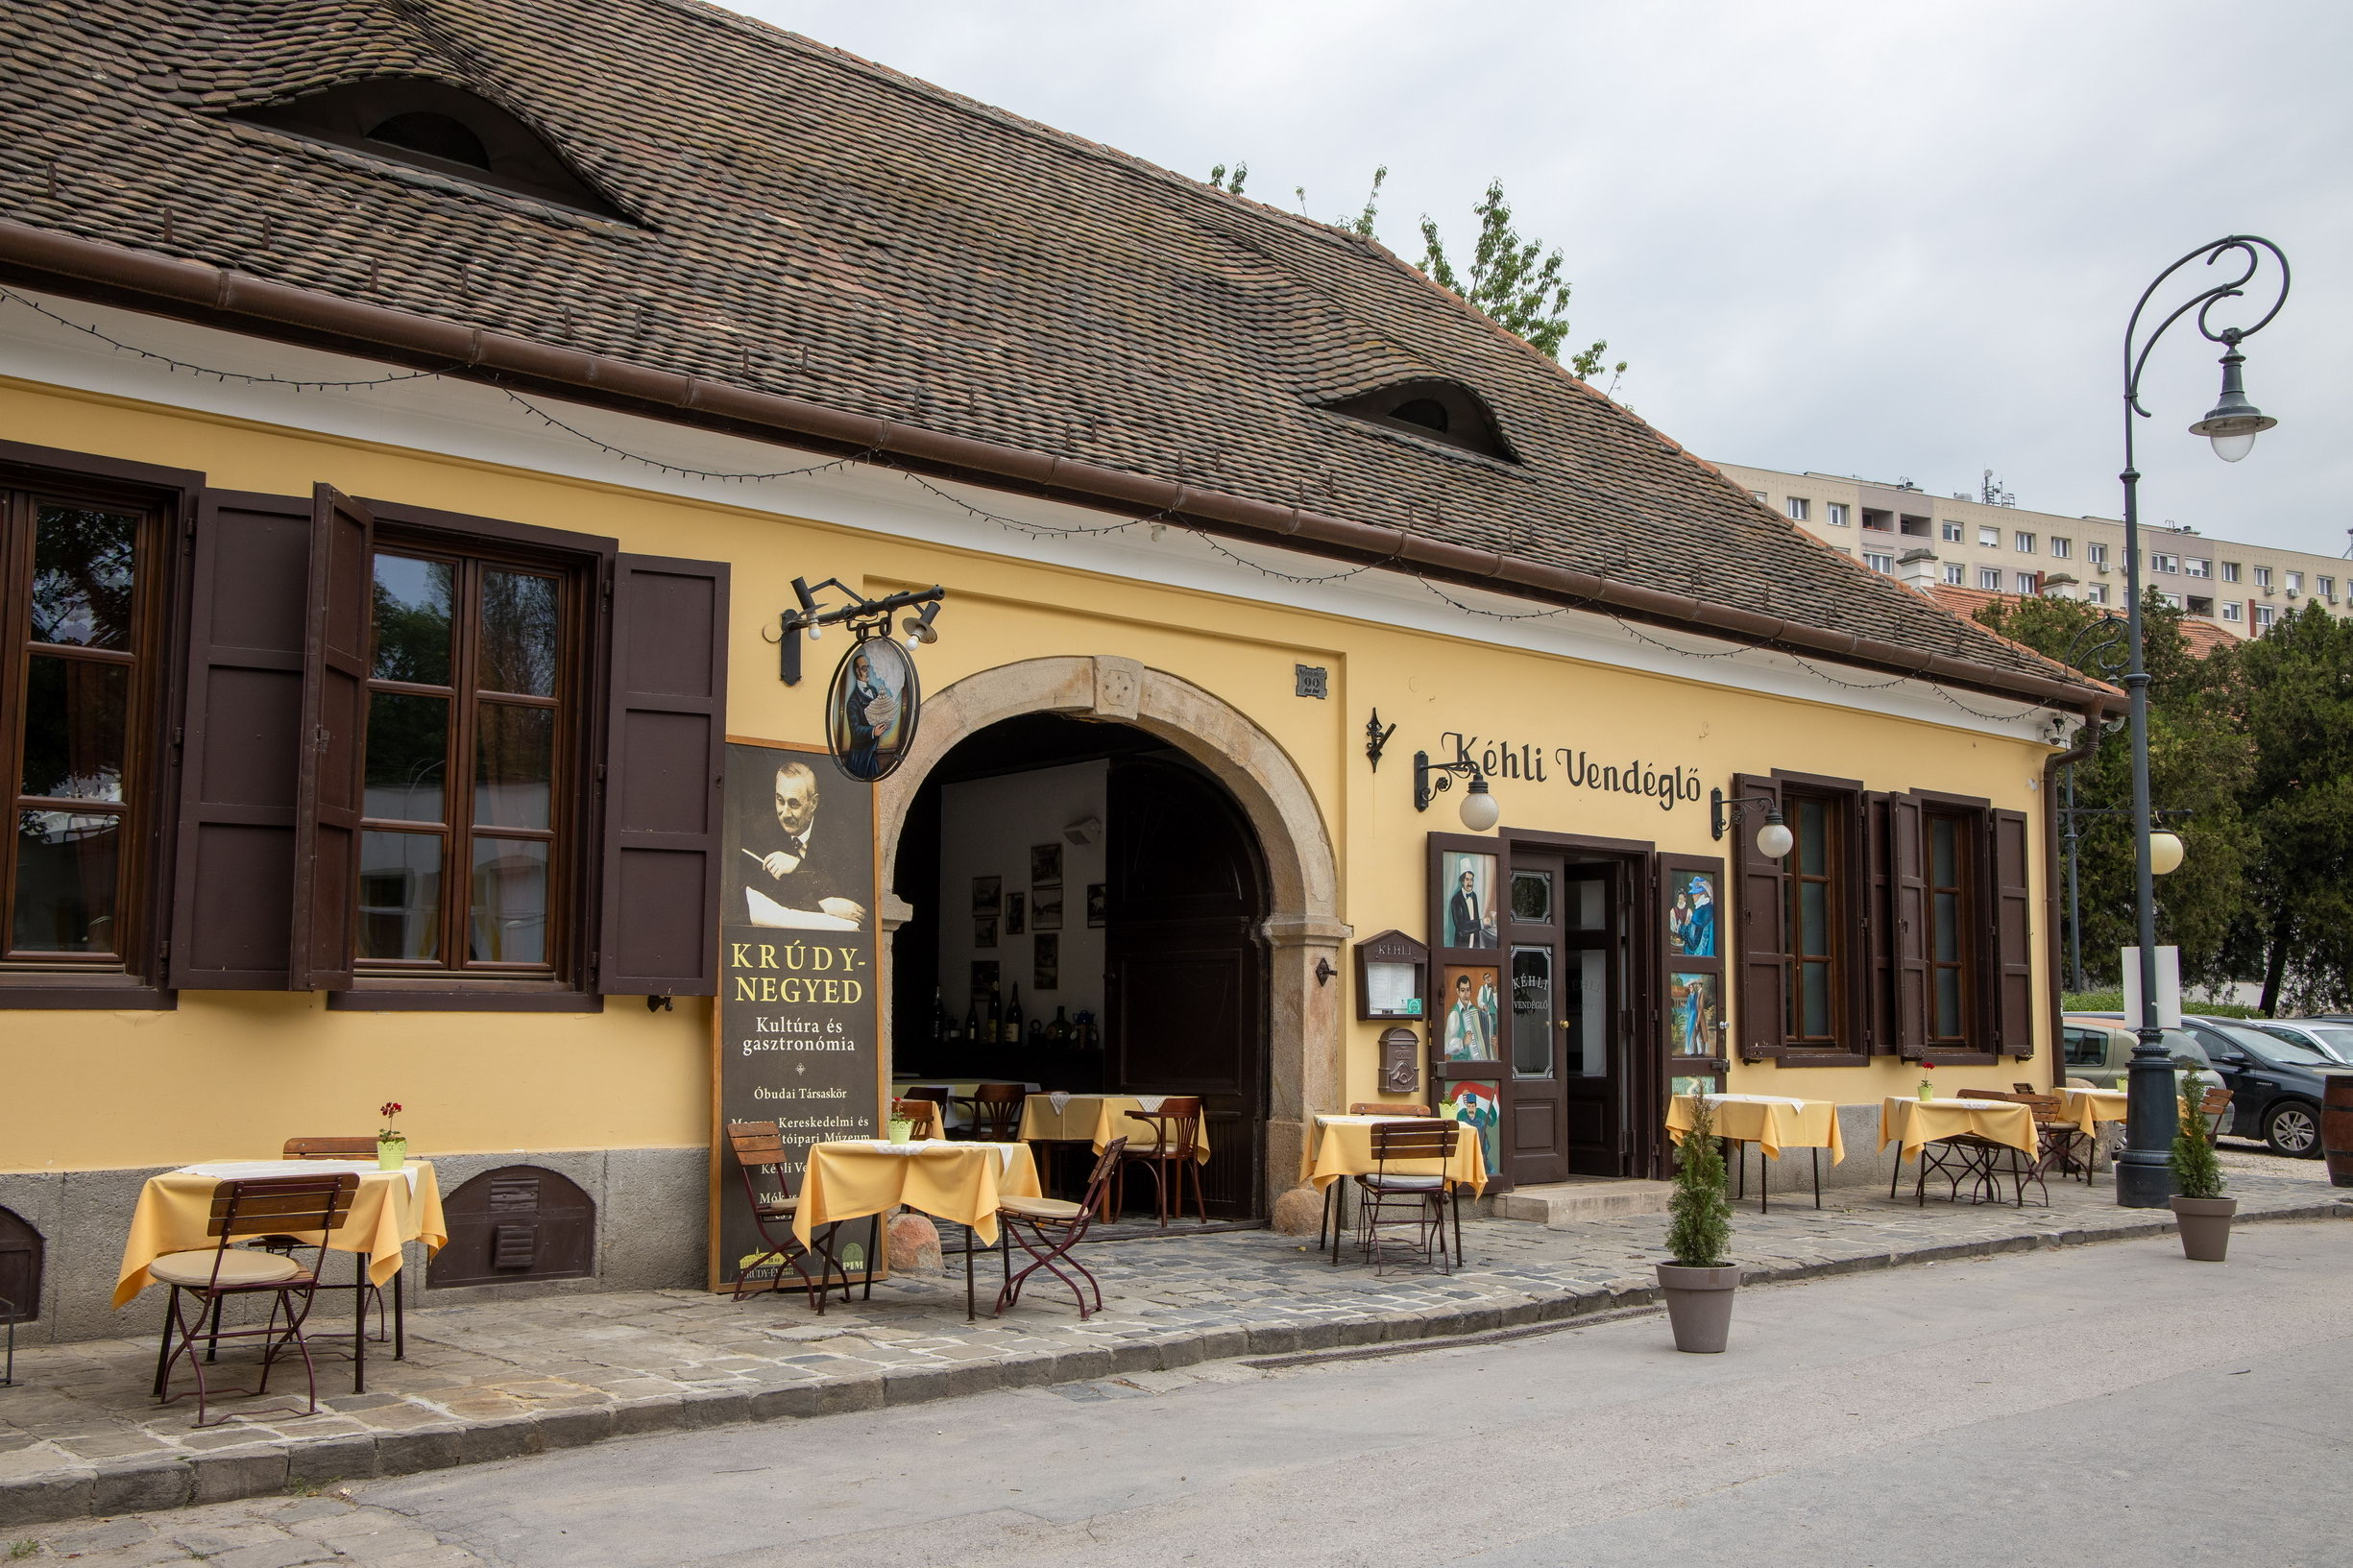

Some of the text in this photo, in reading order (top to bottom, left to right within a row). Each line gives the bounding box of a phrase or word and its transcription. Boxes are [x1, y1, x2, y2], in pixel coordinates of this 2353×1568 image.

[1441, 732, 1701, 811] Kéhli Vendéglő
[731, 940, 866, 972] KRÚDY-
[735, 977, 862, 1003] NEGYED
[1513, 973, 1548, 991] KÉHLI
[756, 1016, 843, 1033] Kultúra és
[742, 1037, 856, 1056] gasztronómia
[754, 1086, 847, 1099] Óbudai Társaskör
[779, 1116, 854, 1128] Kereskedelmi
[858, 1118, 869, 1126] és
[824, 1132, 870, 1144] Múzeum
[842, 1261, 864, 1271] PIM
